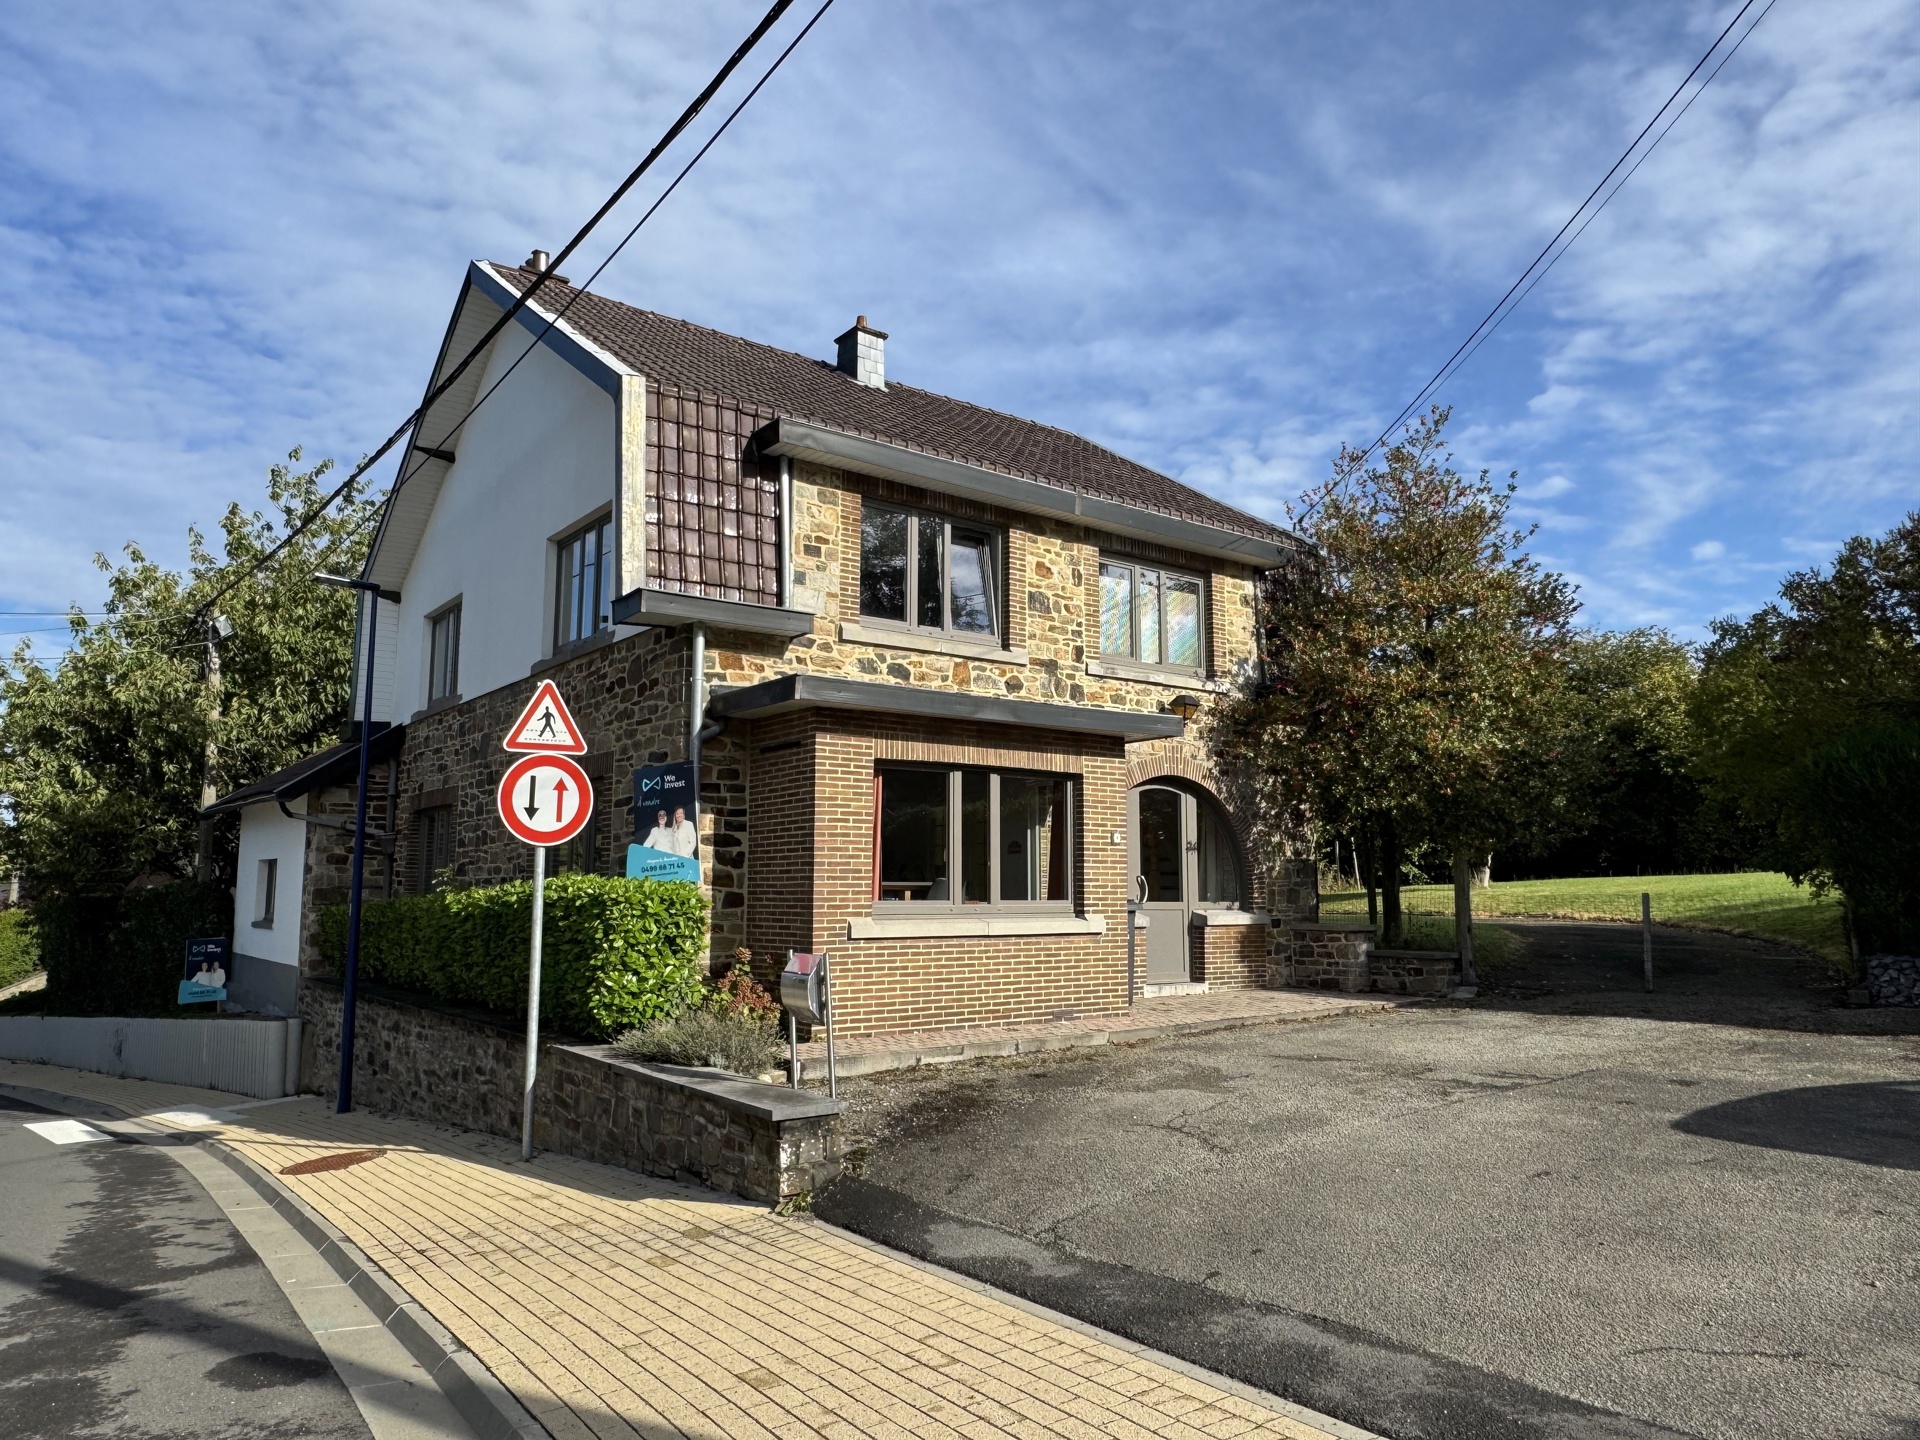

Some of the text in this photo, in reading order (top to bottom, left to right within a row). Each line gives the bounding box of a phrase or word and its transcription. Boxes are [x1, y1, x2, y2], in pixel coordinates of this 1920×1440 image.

[664, 774, 676, 782] We
[664, 780, 686, 789] Invest
[641, 865, 658, 873] 0499
[668, 862, 675, 870] 71
